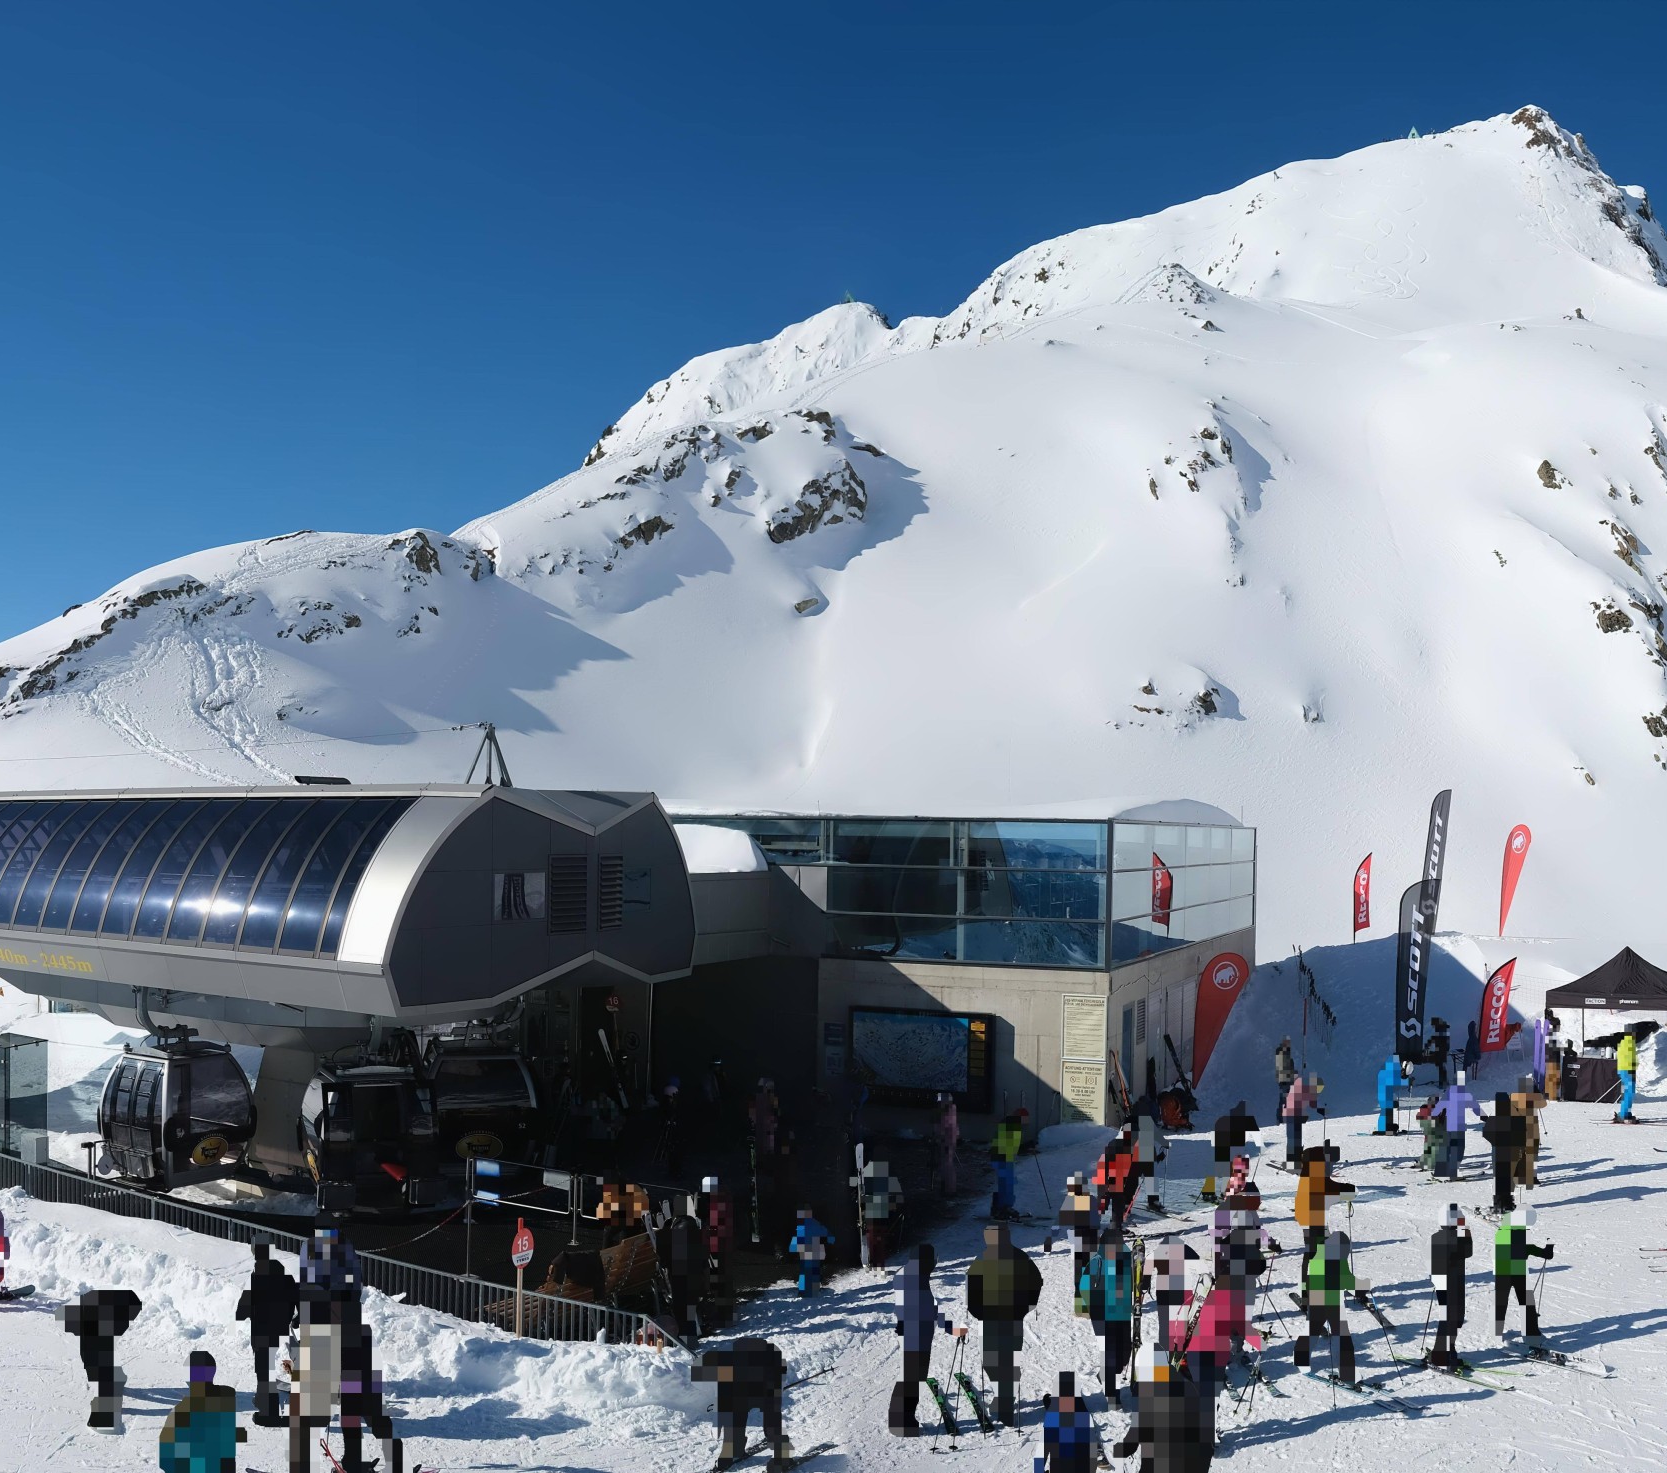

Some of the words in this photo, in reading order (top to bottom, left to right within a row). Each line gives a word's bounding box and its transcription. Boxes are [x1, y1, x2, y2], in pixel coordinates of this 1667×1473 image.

[1427, 811, 1444, 893] SCOTT
[40, 952, 93, 972] 2445m
[1407, 904, 1425, 1016] SCOTT
[1487, 981, 1507, 1044] RECCO
[517, 1236, 529, 1253] 15
